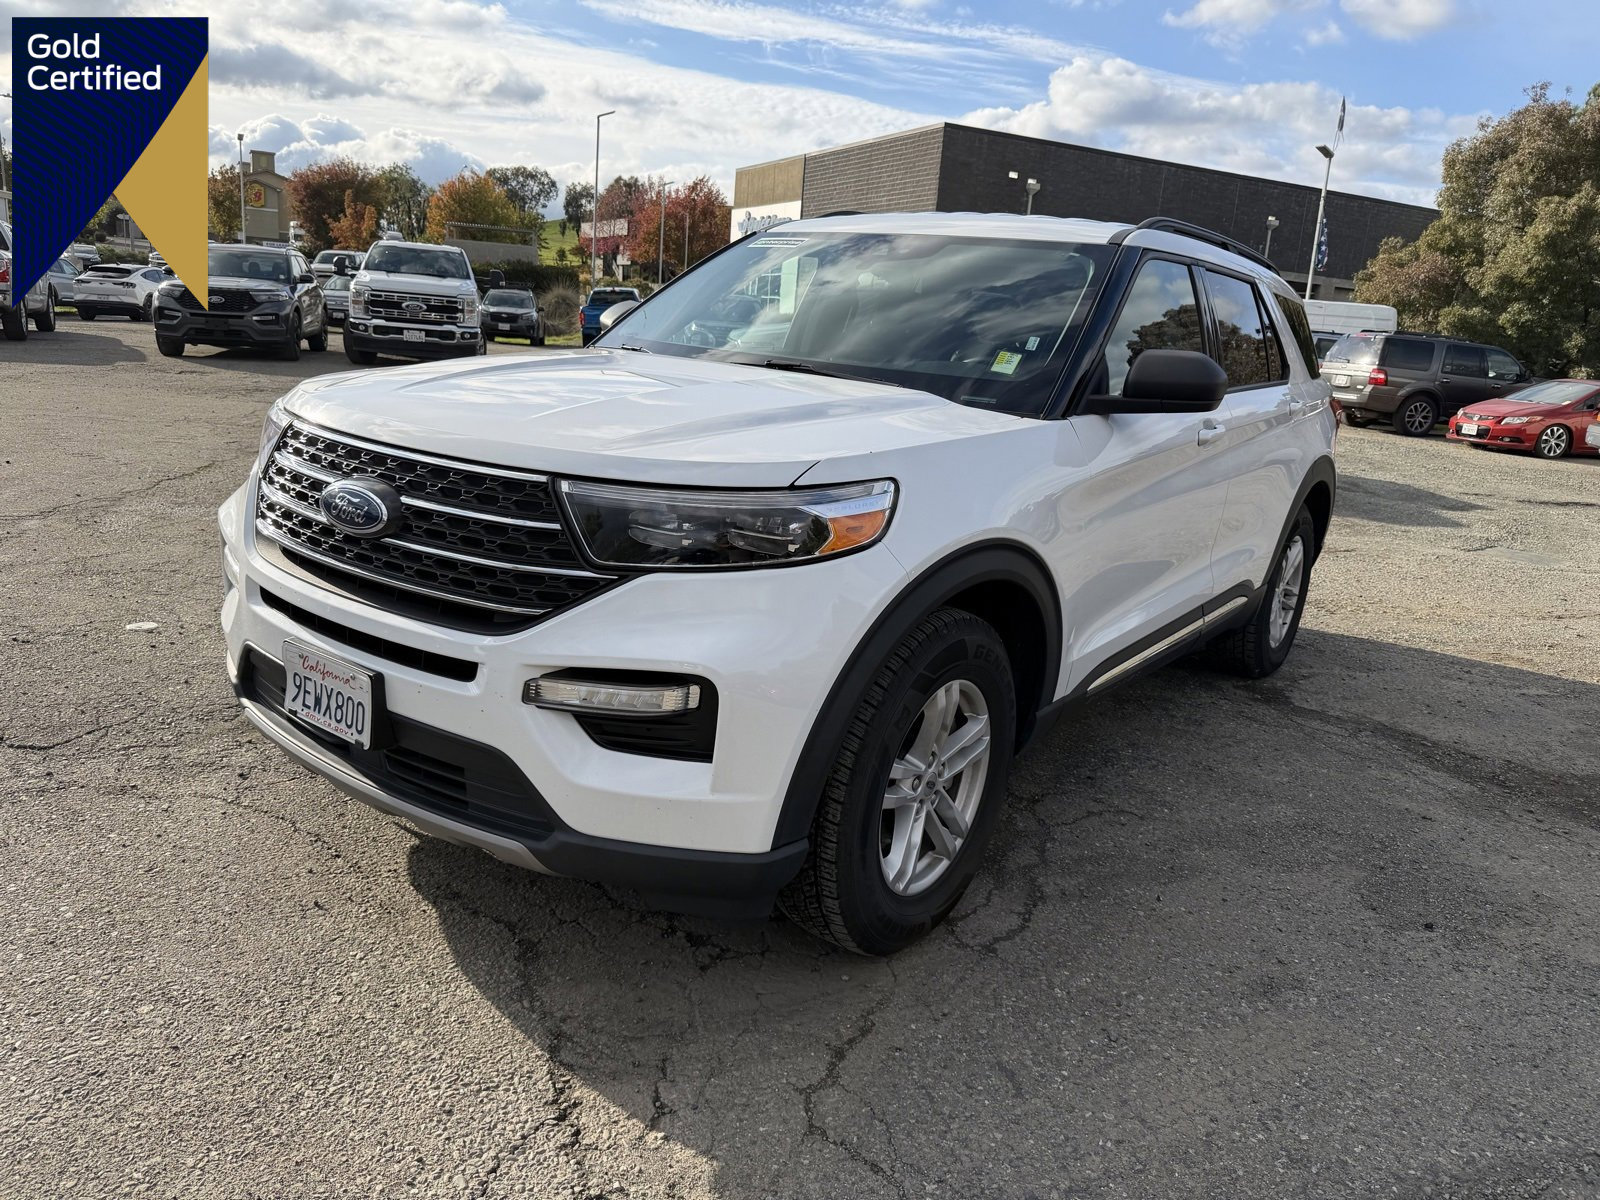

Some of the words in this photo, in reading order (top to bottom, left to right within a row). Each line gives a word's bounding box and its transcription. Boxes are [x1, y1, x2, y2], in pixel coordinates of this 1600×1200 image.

[330, 492, 369, 524] Ford
[302, 655, 356, 691] California
[291, 671, 366, 736] 9EWX800
